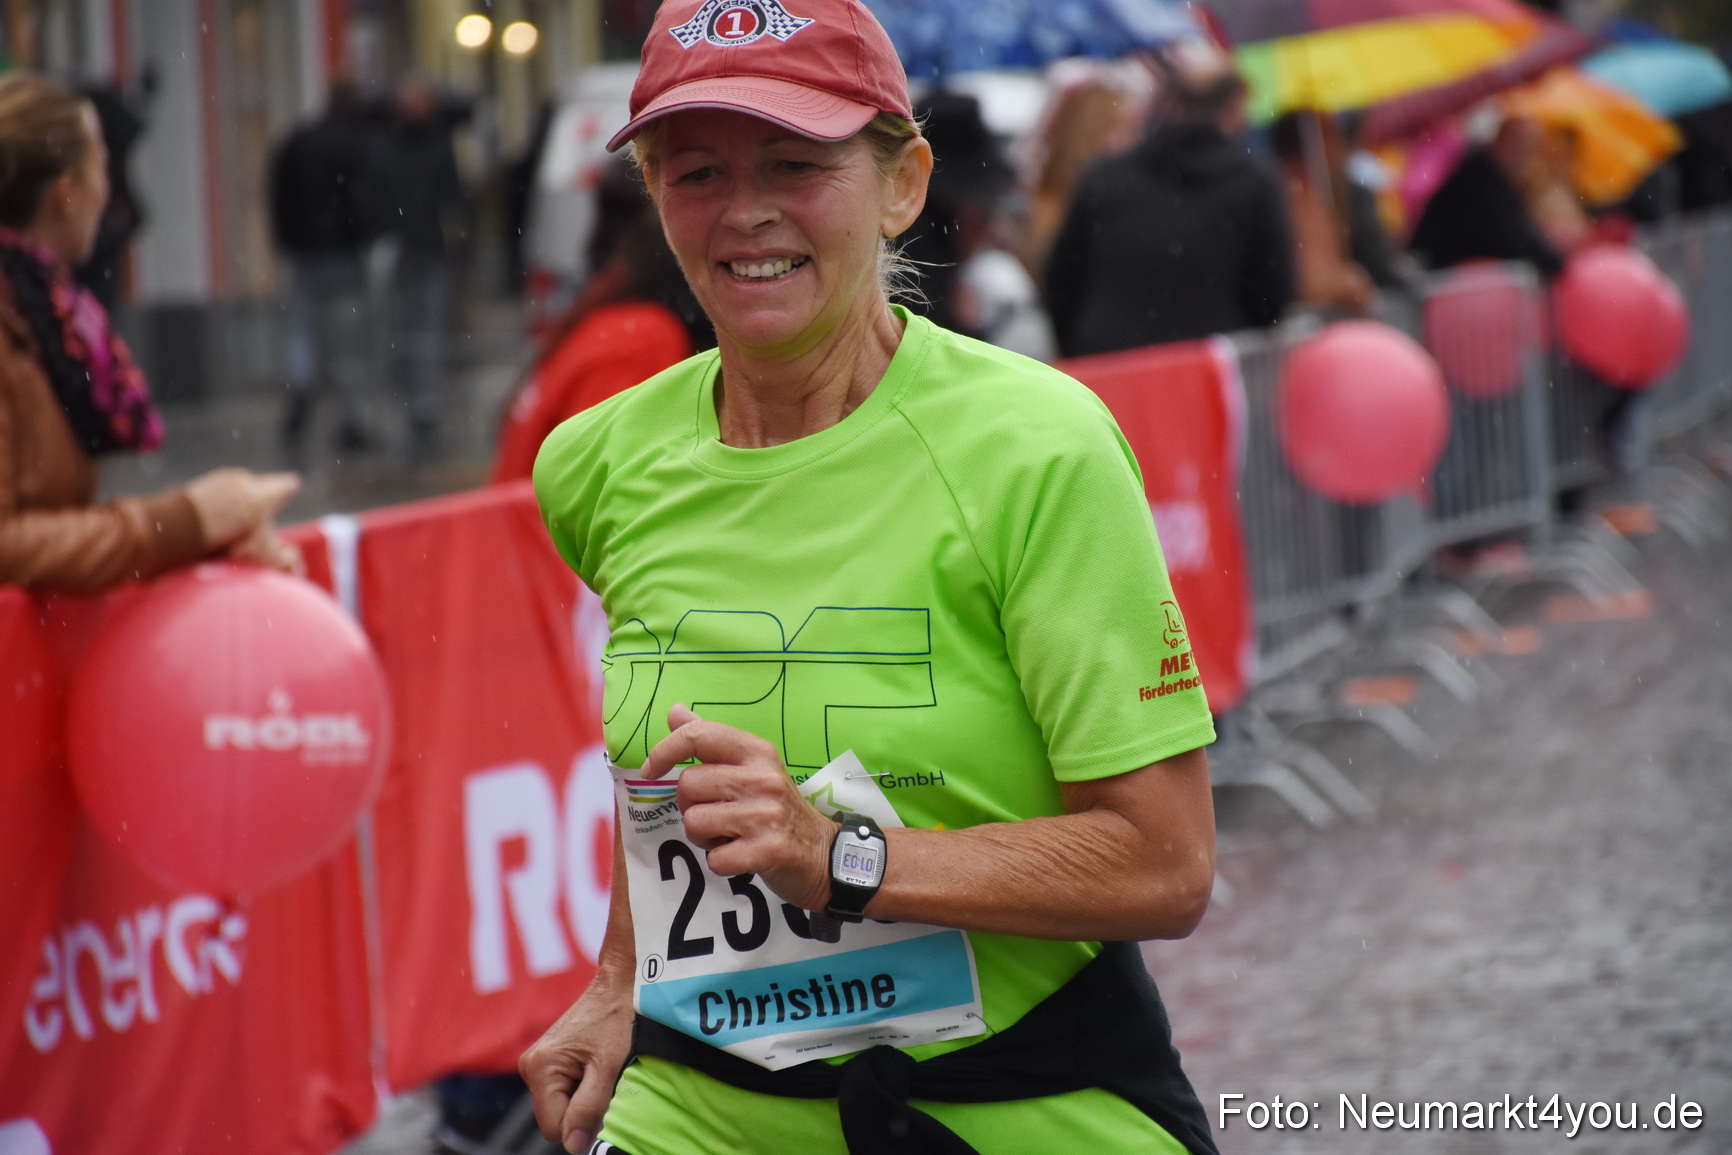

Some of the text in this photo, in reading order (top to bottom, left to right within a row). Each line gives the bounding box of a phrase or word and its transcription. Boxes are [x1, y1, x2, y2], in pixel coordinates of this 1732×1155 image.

[726, 12, 745, 35] 1
[1160, 650, 1196, 677] ME
[879, 770, 946, 789] GmbH
[647, 958, 659, 980] D
[699, 973, 896, 1036] Christine
